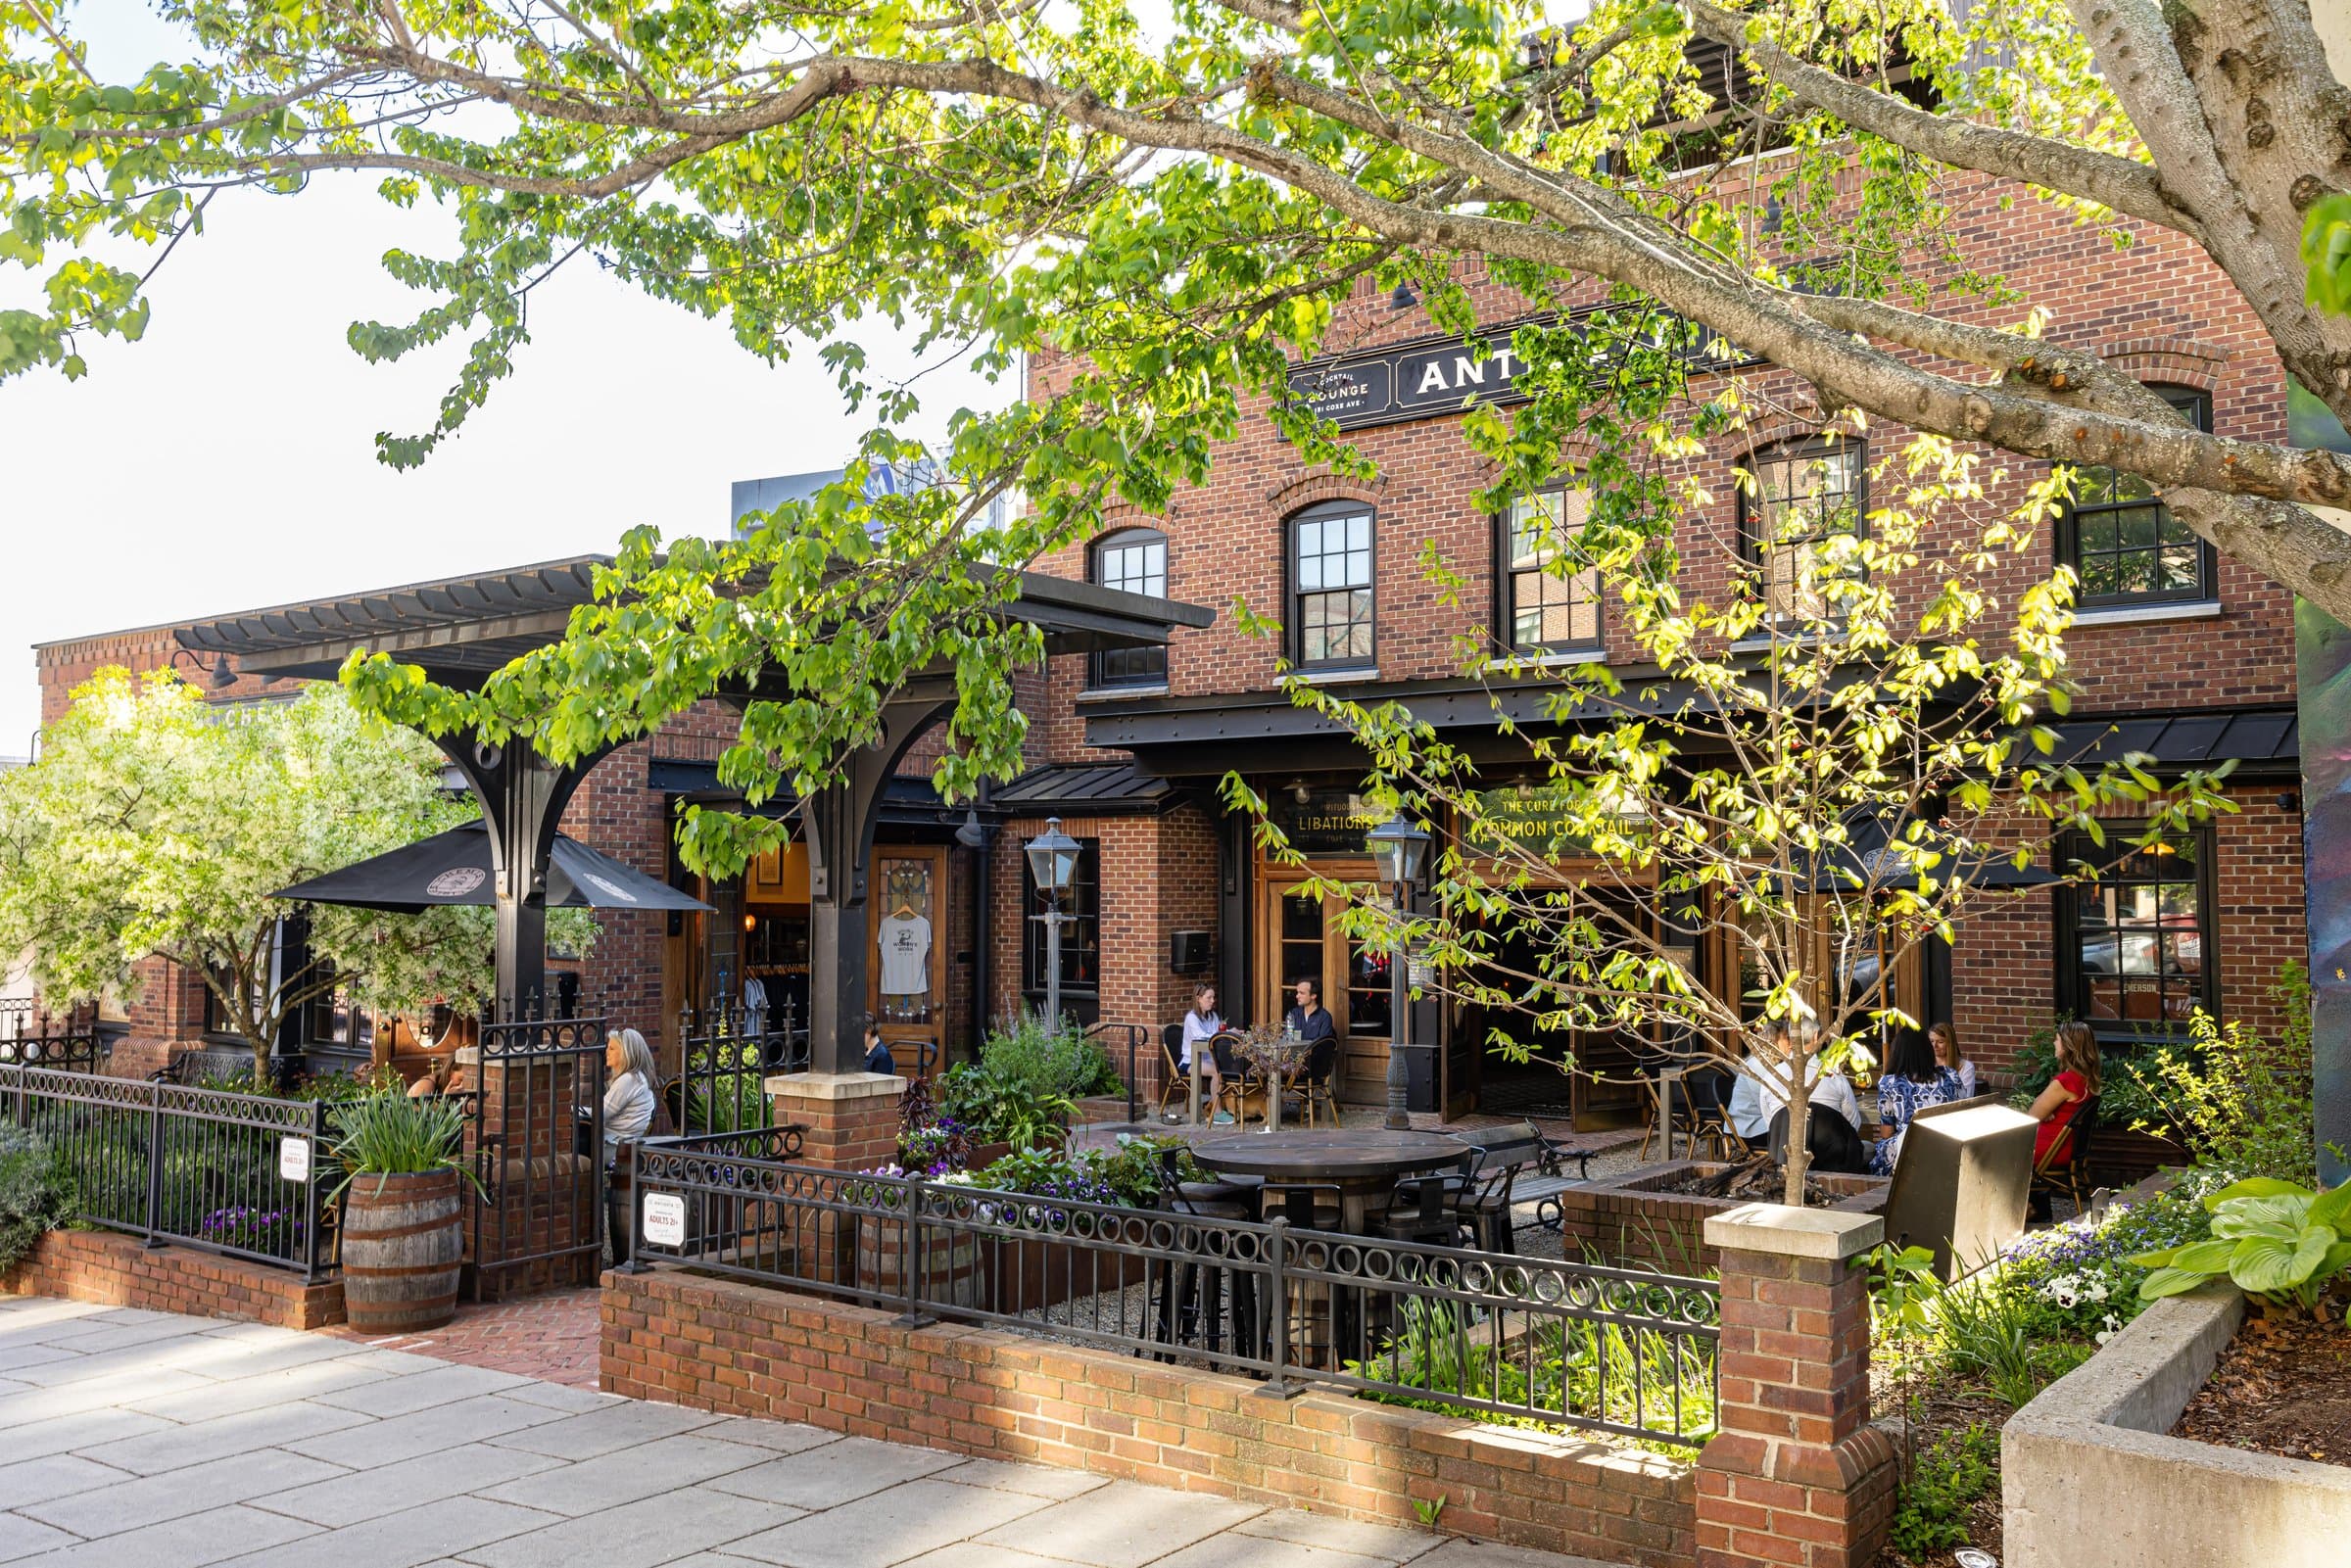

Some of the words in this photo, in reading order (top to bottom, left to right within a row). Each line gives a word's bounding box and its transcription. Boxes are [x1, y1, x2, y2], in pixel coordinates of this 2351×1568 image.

[1319, 373, 1354, 386] COCKTAIL
[1502, 800, 1523, 813] THE
[1526, 799, 1556, 813] CURE
[1299, 816, 1373, 832] LIBATIONS
[1479, 819, 1548, 838] COMMON
[1554, 819, 1634, 837] COKTAIL
[648, 1214, 669, 1226] ADULTS
